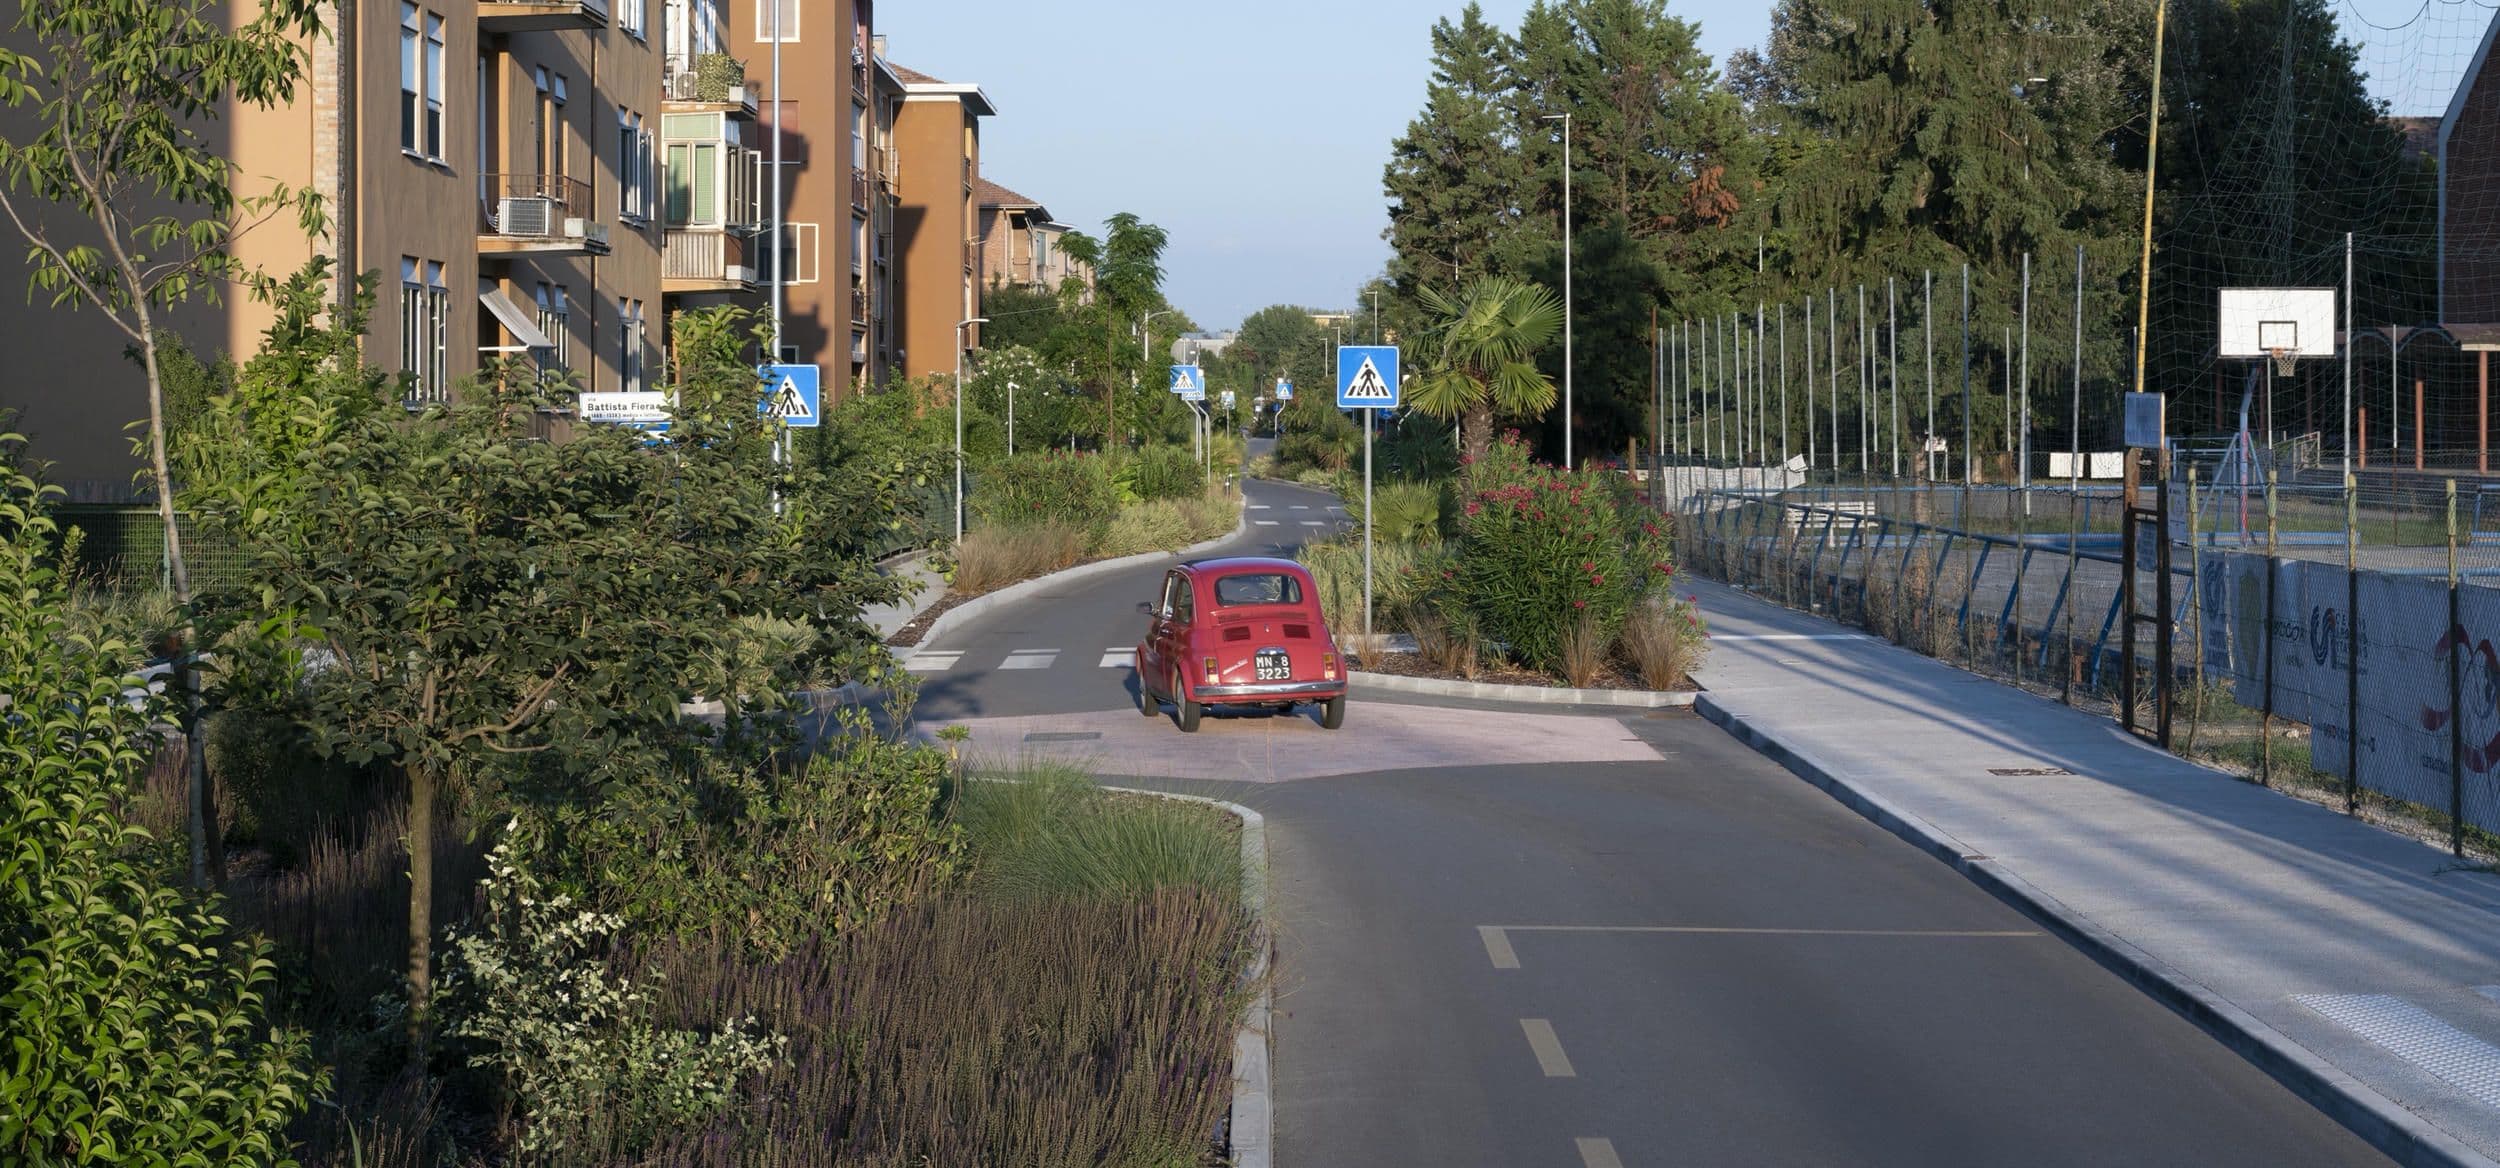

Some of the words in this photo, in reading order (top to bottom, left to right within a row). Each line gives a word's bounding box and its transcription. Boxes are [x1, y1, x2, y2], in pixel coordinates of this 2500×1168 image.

[588, 403, 627, 411] Battista
[1256, 656, 1272, 667] MN
[1281, 656, 1288, 666] 8
[1257, 668, 1290, 679] 3223
